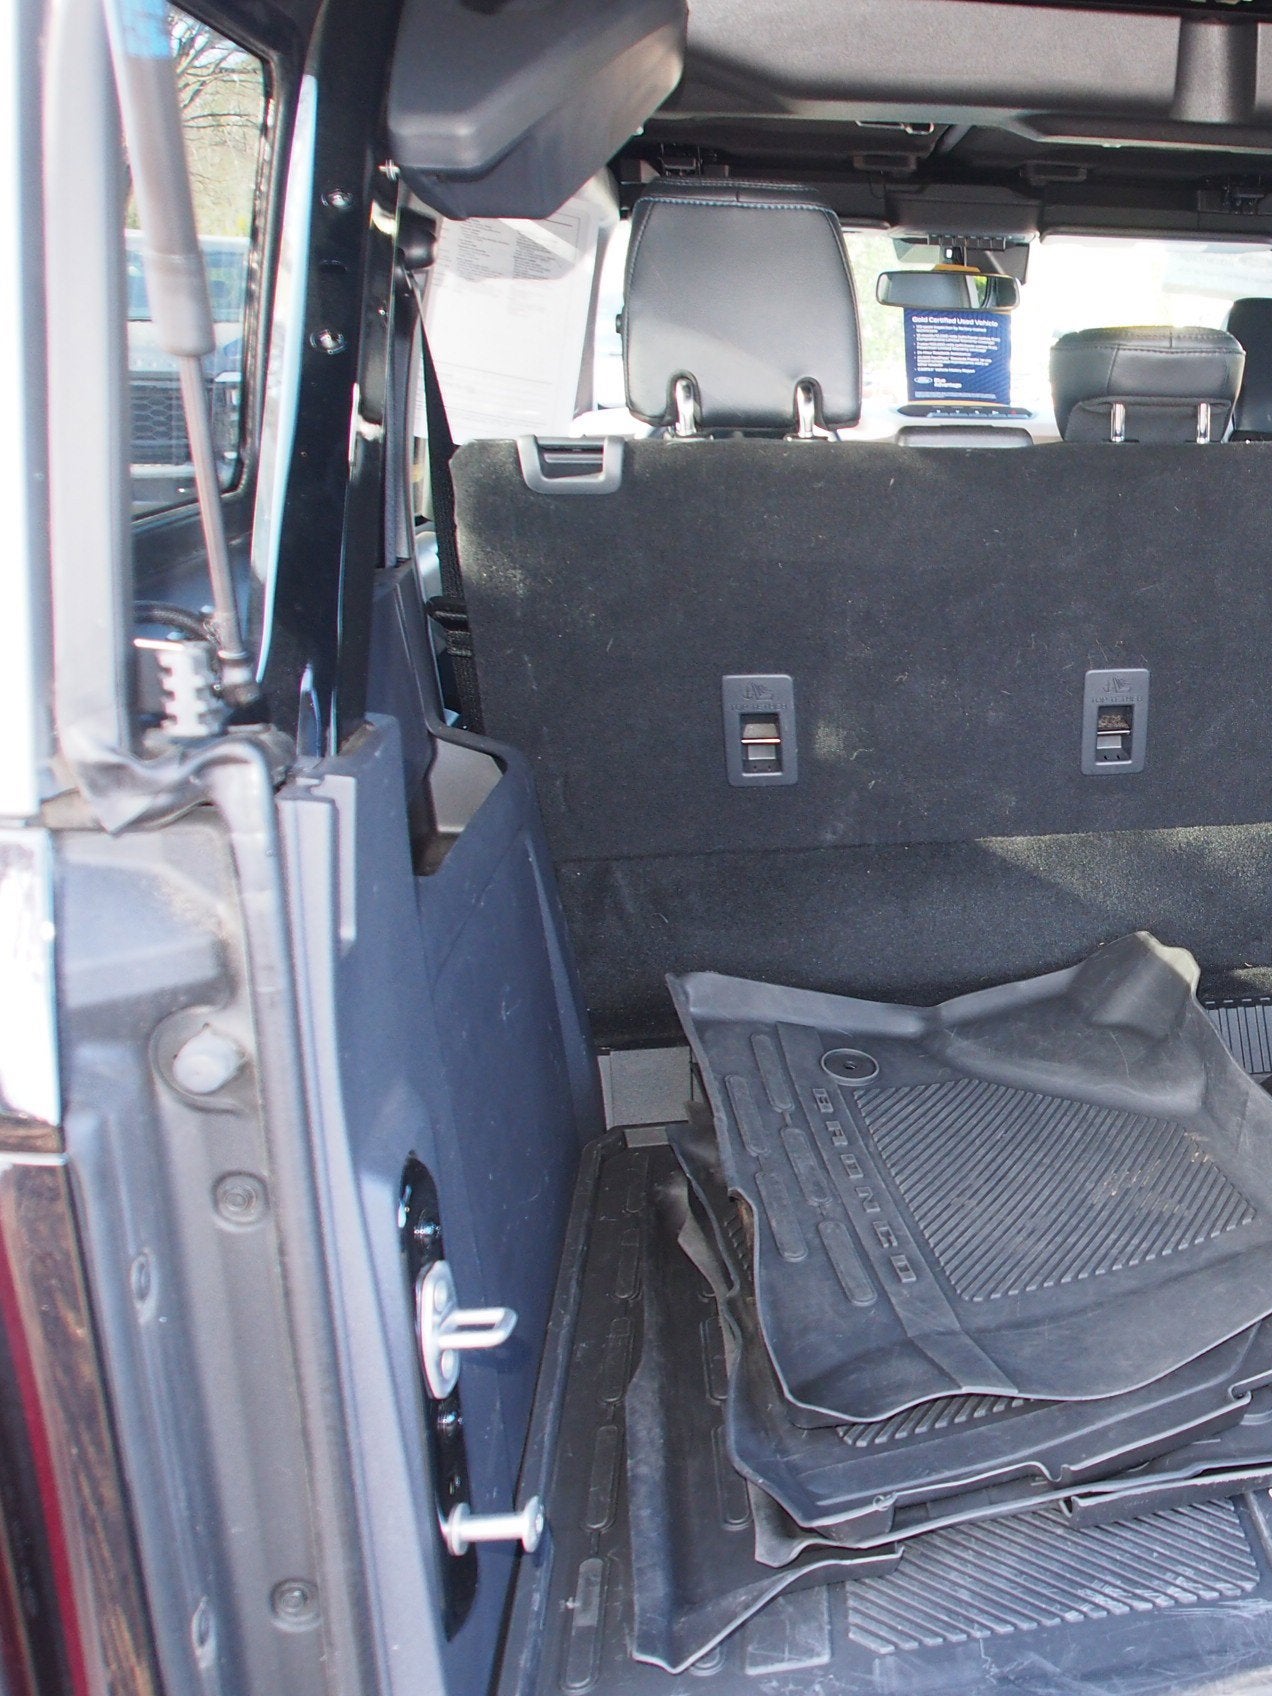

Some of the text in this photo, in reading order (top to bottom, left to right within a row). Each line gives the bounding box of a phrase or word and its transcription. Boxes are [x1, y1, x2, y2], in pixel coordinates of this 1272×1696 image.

[929, 316, 956, 324] Certified
[975, 319, 998, 327] Vehicle
[812, 1088, 917, 1284] BRONCO
